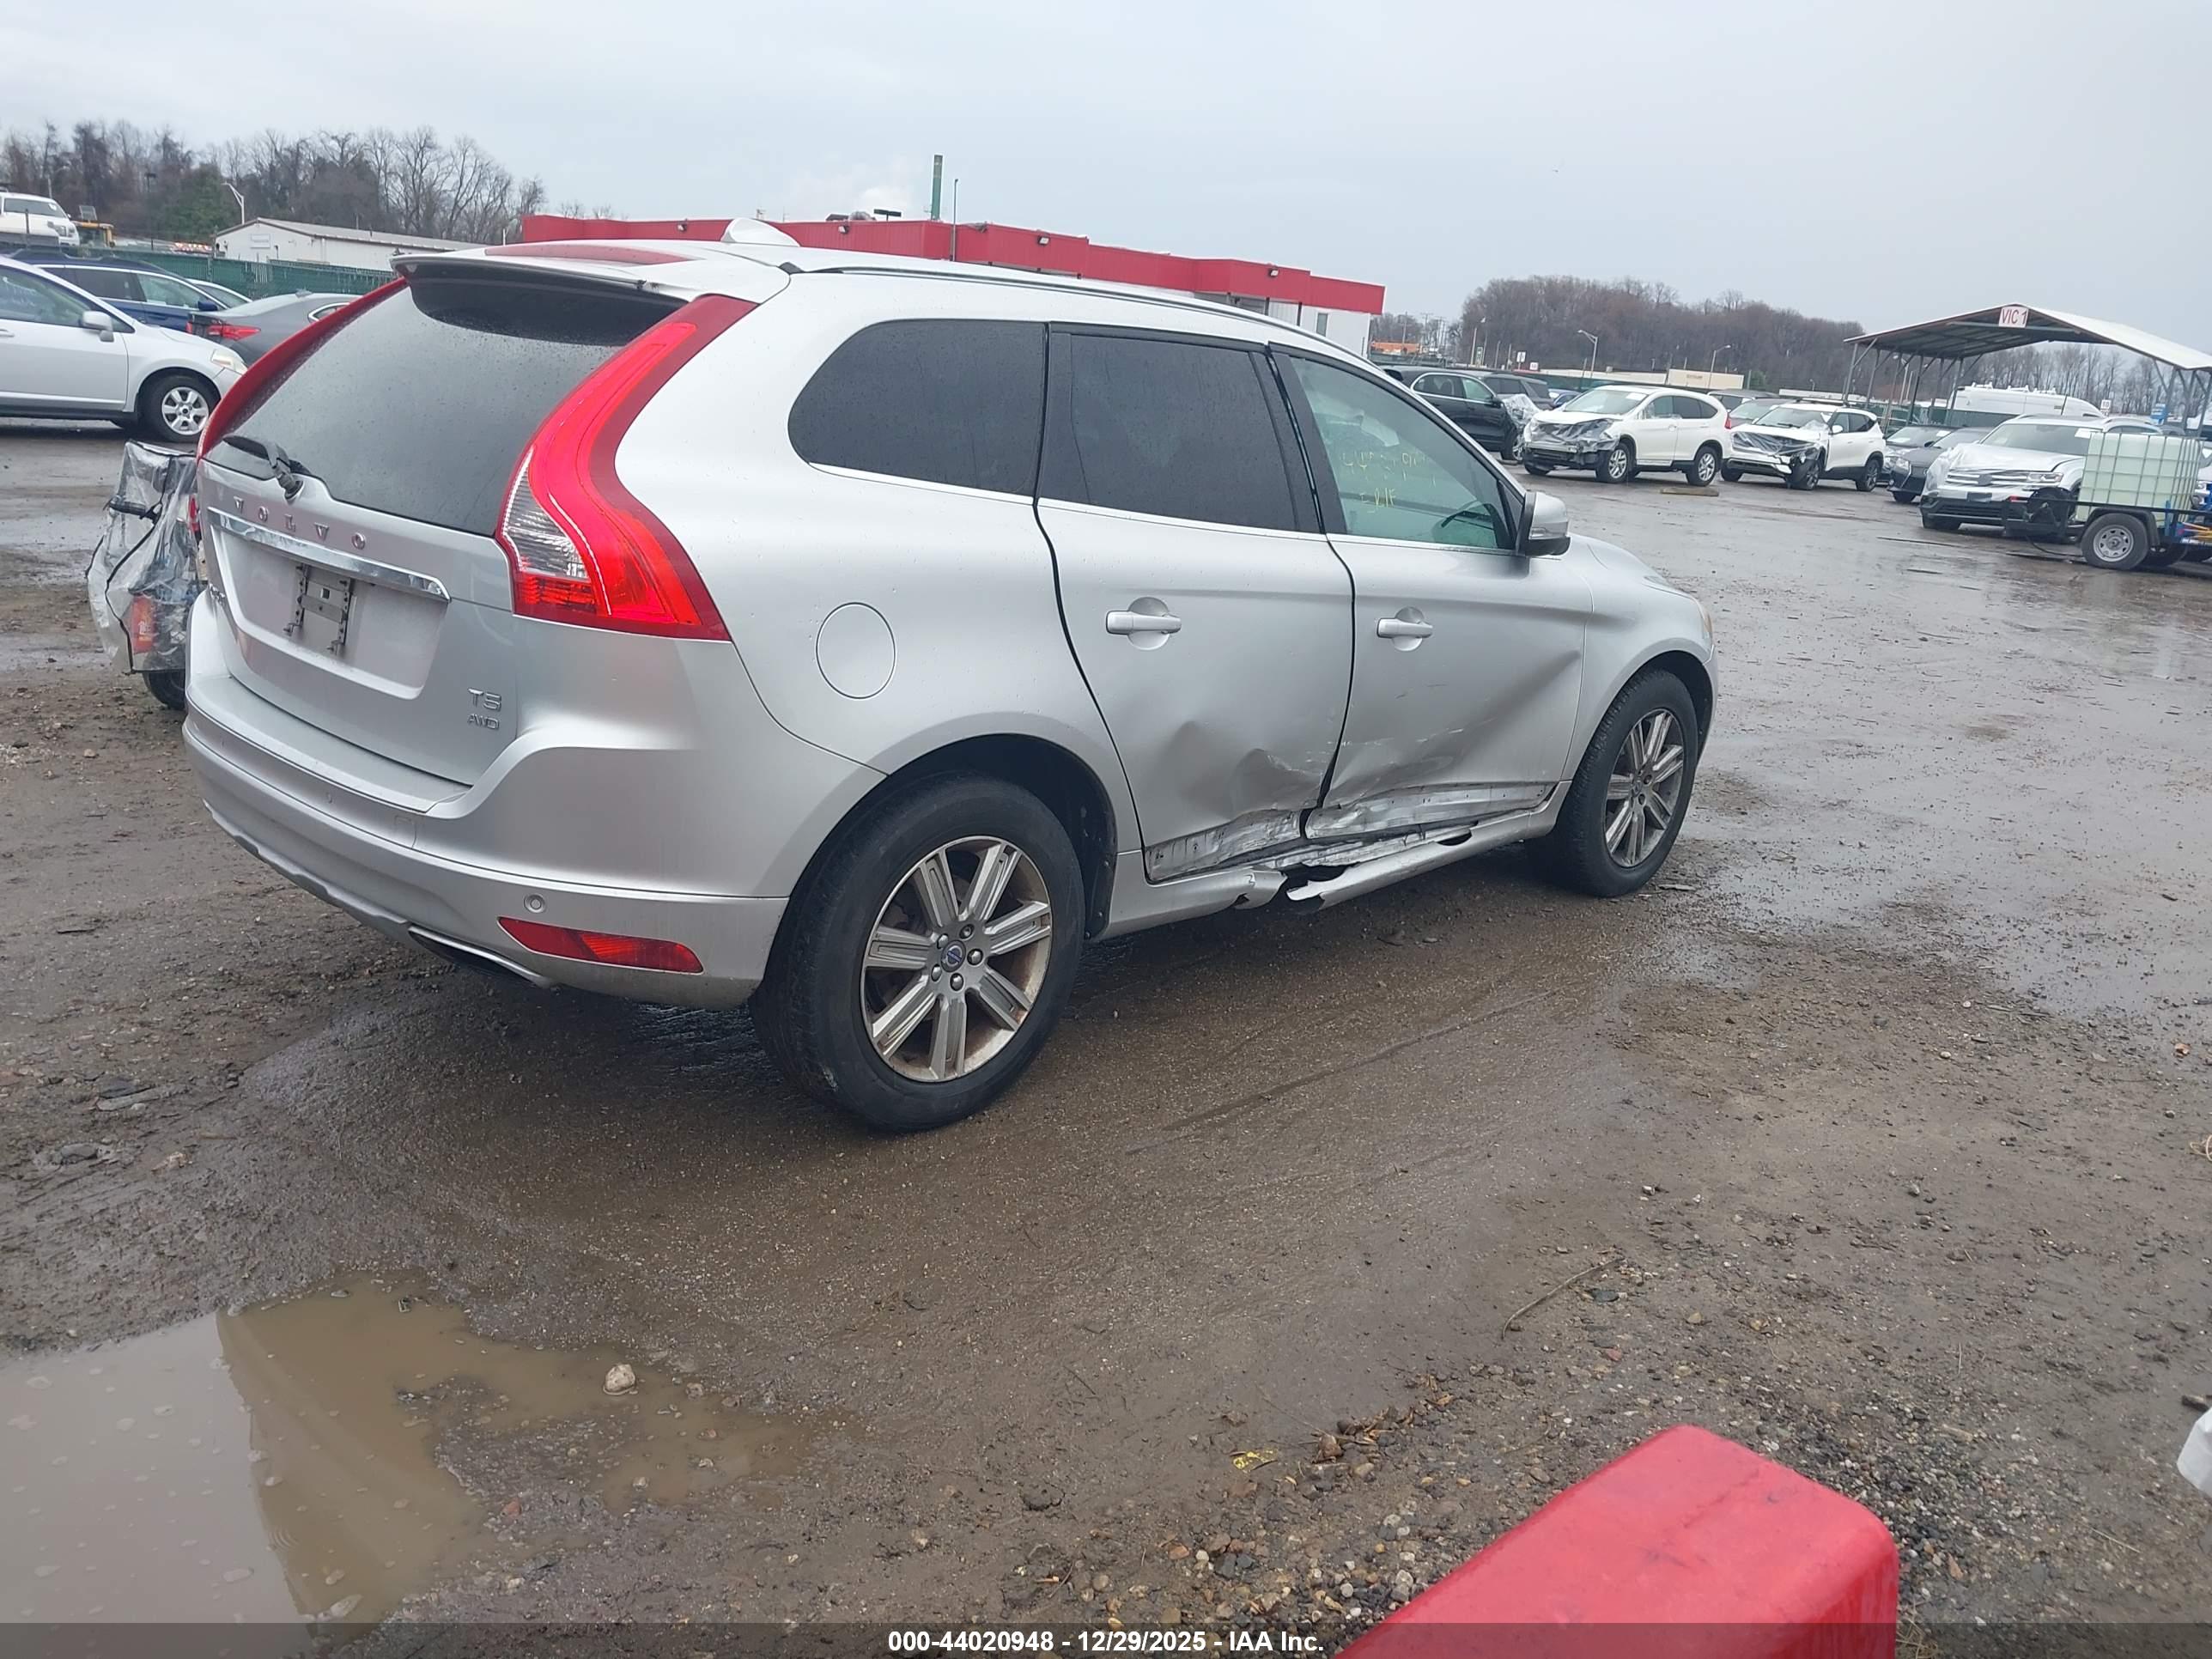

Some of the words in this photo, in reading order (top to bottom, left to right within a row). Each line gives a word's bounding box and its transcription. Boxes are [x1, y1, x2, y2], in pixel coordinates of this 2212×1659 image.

[2002, 309, 2019, 325] VIC
[2021, 310, 2027, 325] 1
[233, 495, 366, 550] VOLVO
[467, 688, 501, 712] T5
[467, 714, 499, 730] AWD
